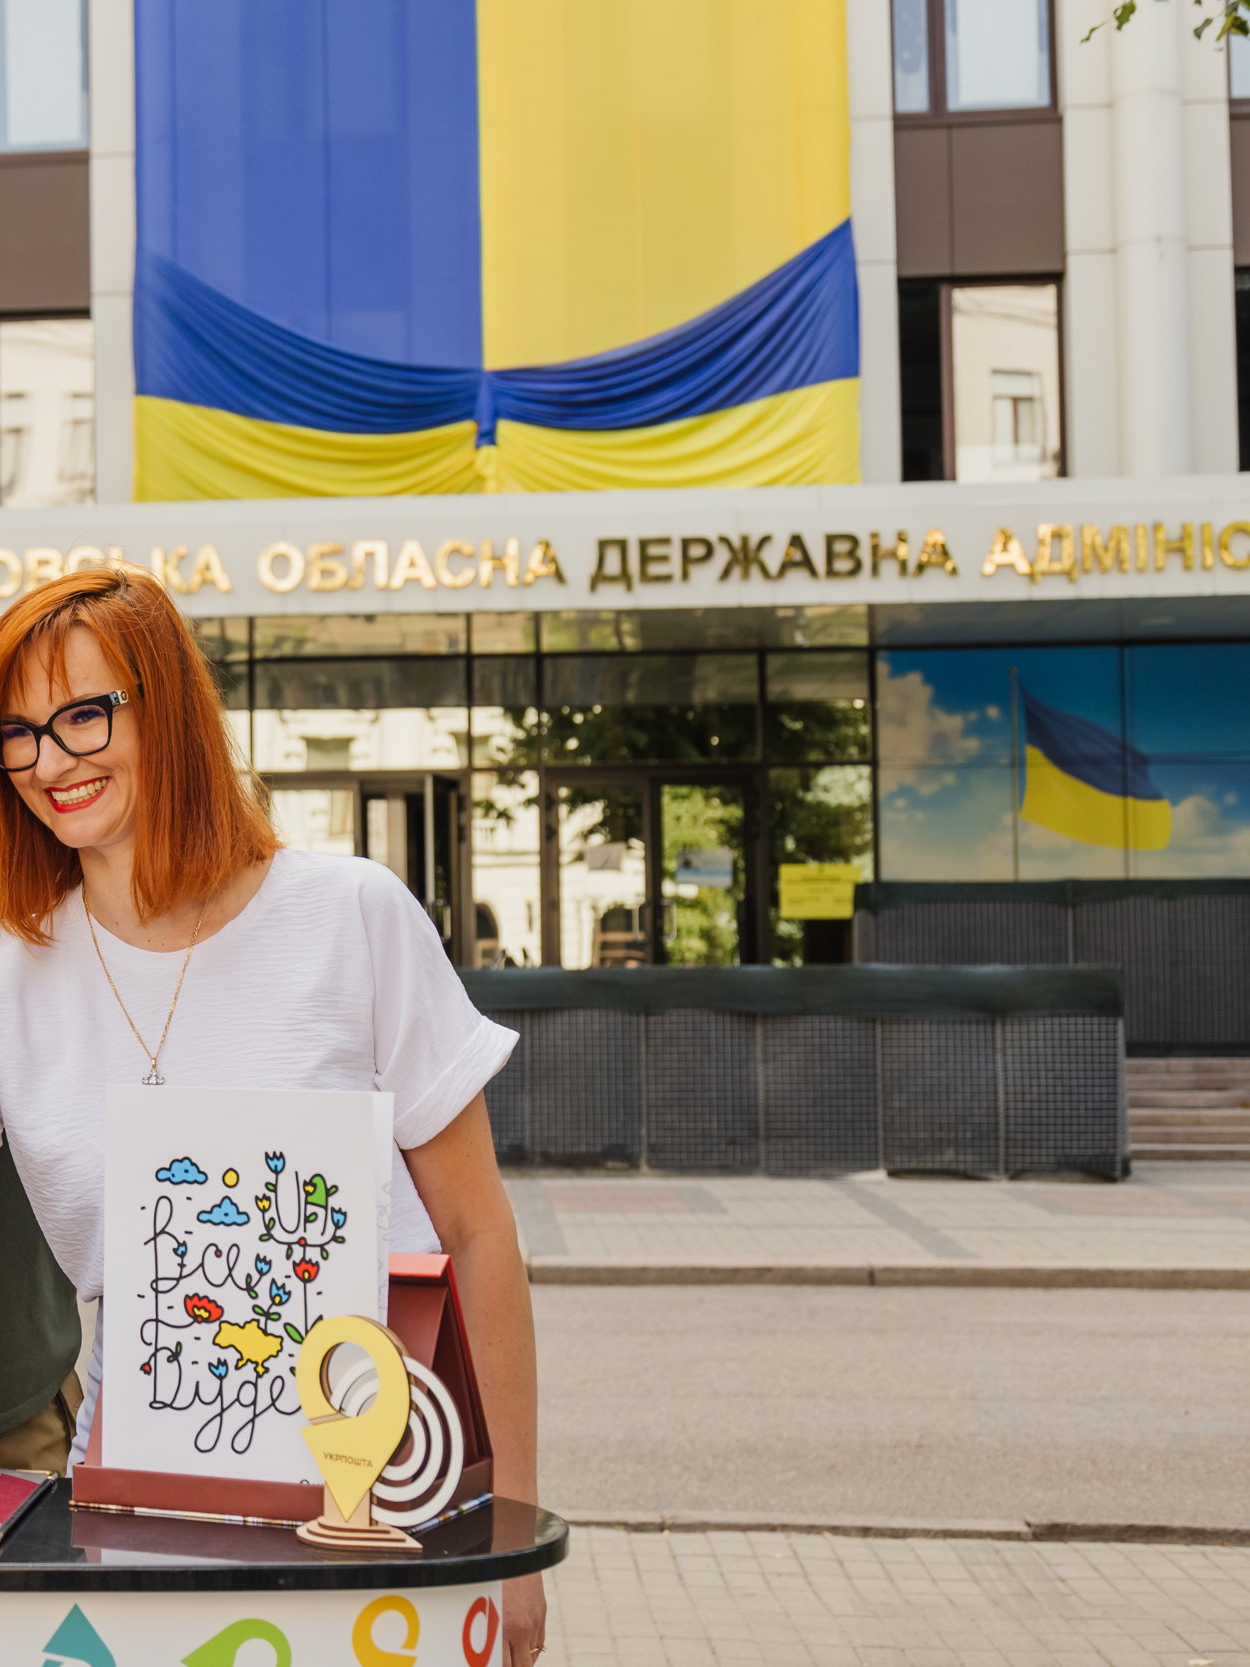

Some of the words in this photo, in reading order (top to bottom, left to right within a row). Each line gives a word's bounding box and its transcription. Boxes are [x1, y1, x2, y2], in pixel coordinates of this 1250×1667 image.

[256, 537, 567, 593] ОБЛАСНА
[590, 528, 958, 593] ДЕРЖАВНА
[981, 521, 1250, 583] АДМІНІС
[323, 1451, 373, 1468] УКРПОШТА
